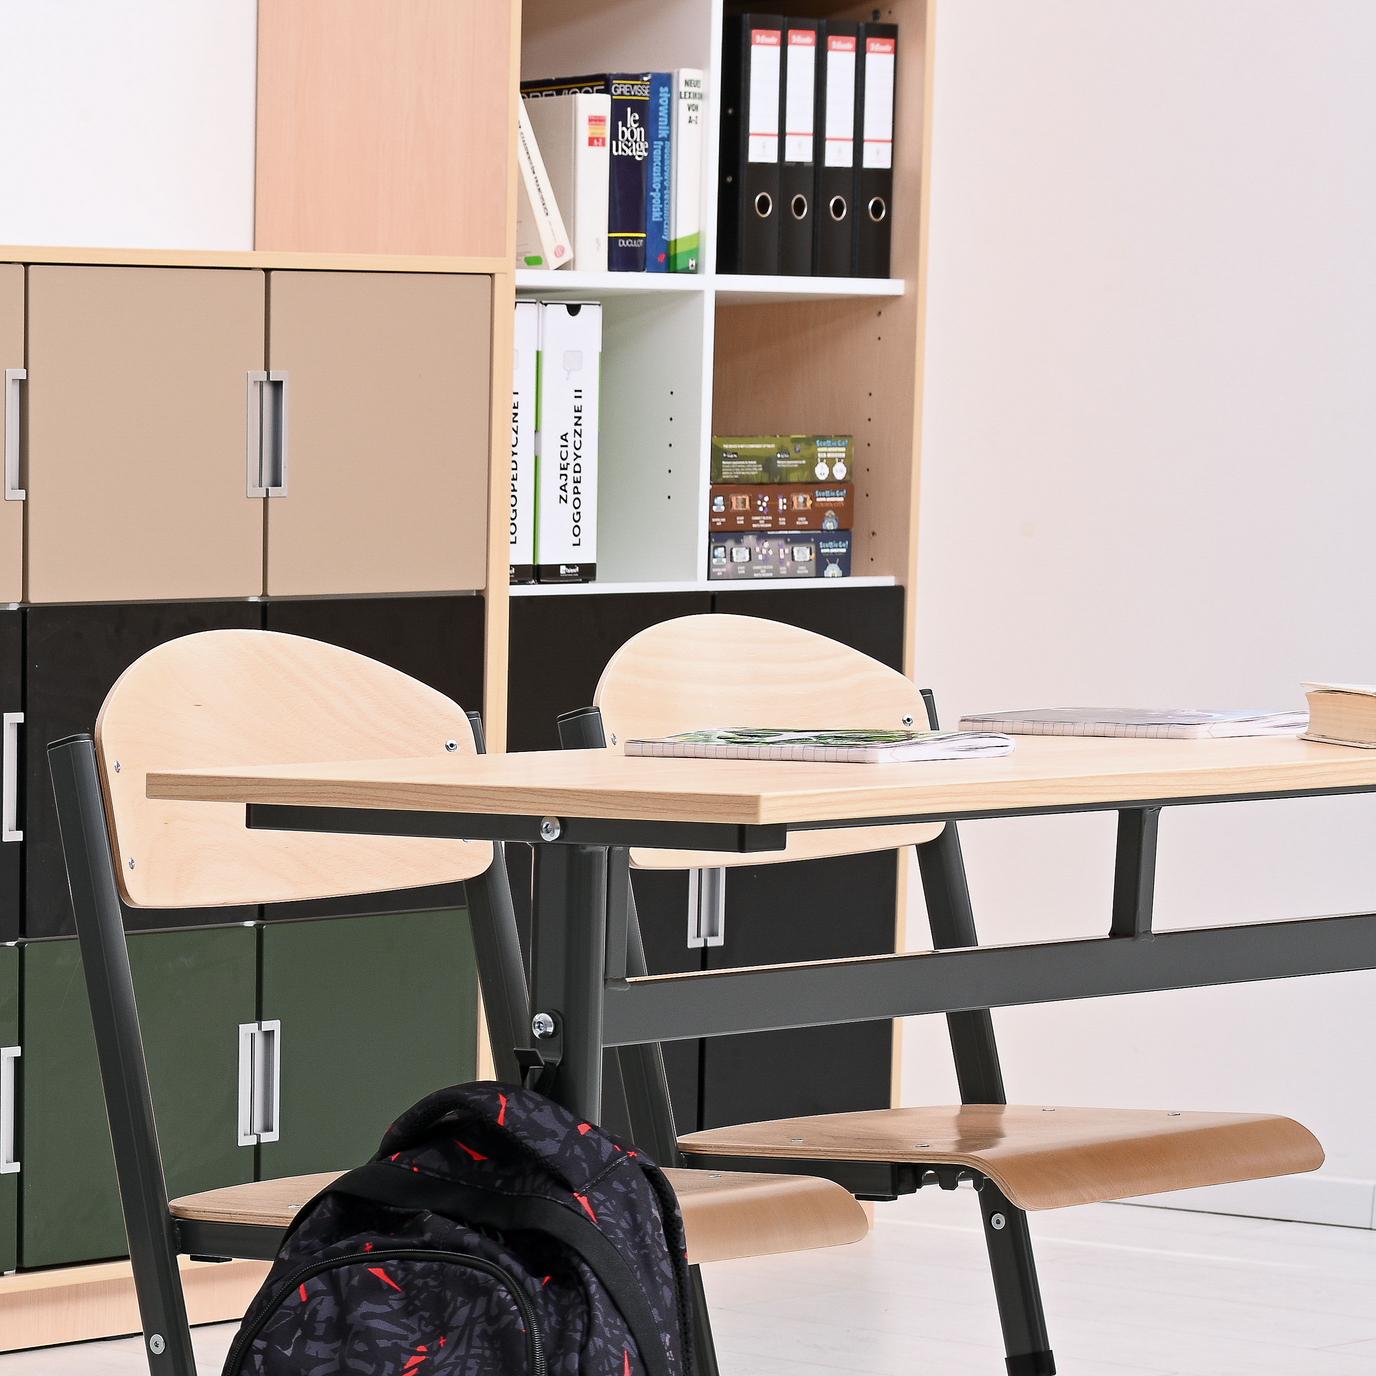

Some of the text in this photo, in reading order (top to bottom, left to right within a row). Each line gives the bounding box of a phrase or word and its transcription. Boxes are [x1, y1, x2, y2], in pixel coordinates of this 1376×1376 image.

[612, 84, 650, 97] GREVISSE
[626, 107, 639, 128] le
[658, 86, 669, 139] słownik
[612, 140, 648, 160] usage
[618, 121, 644, 142] bon
[652, 141, 664, 222] francusko-polski
[559, 431, 570, 504] ZAJĘCIA
[572, 389, 582, 547] LOGOPEDYCZNE II
